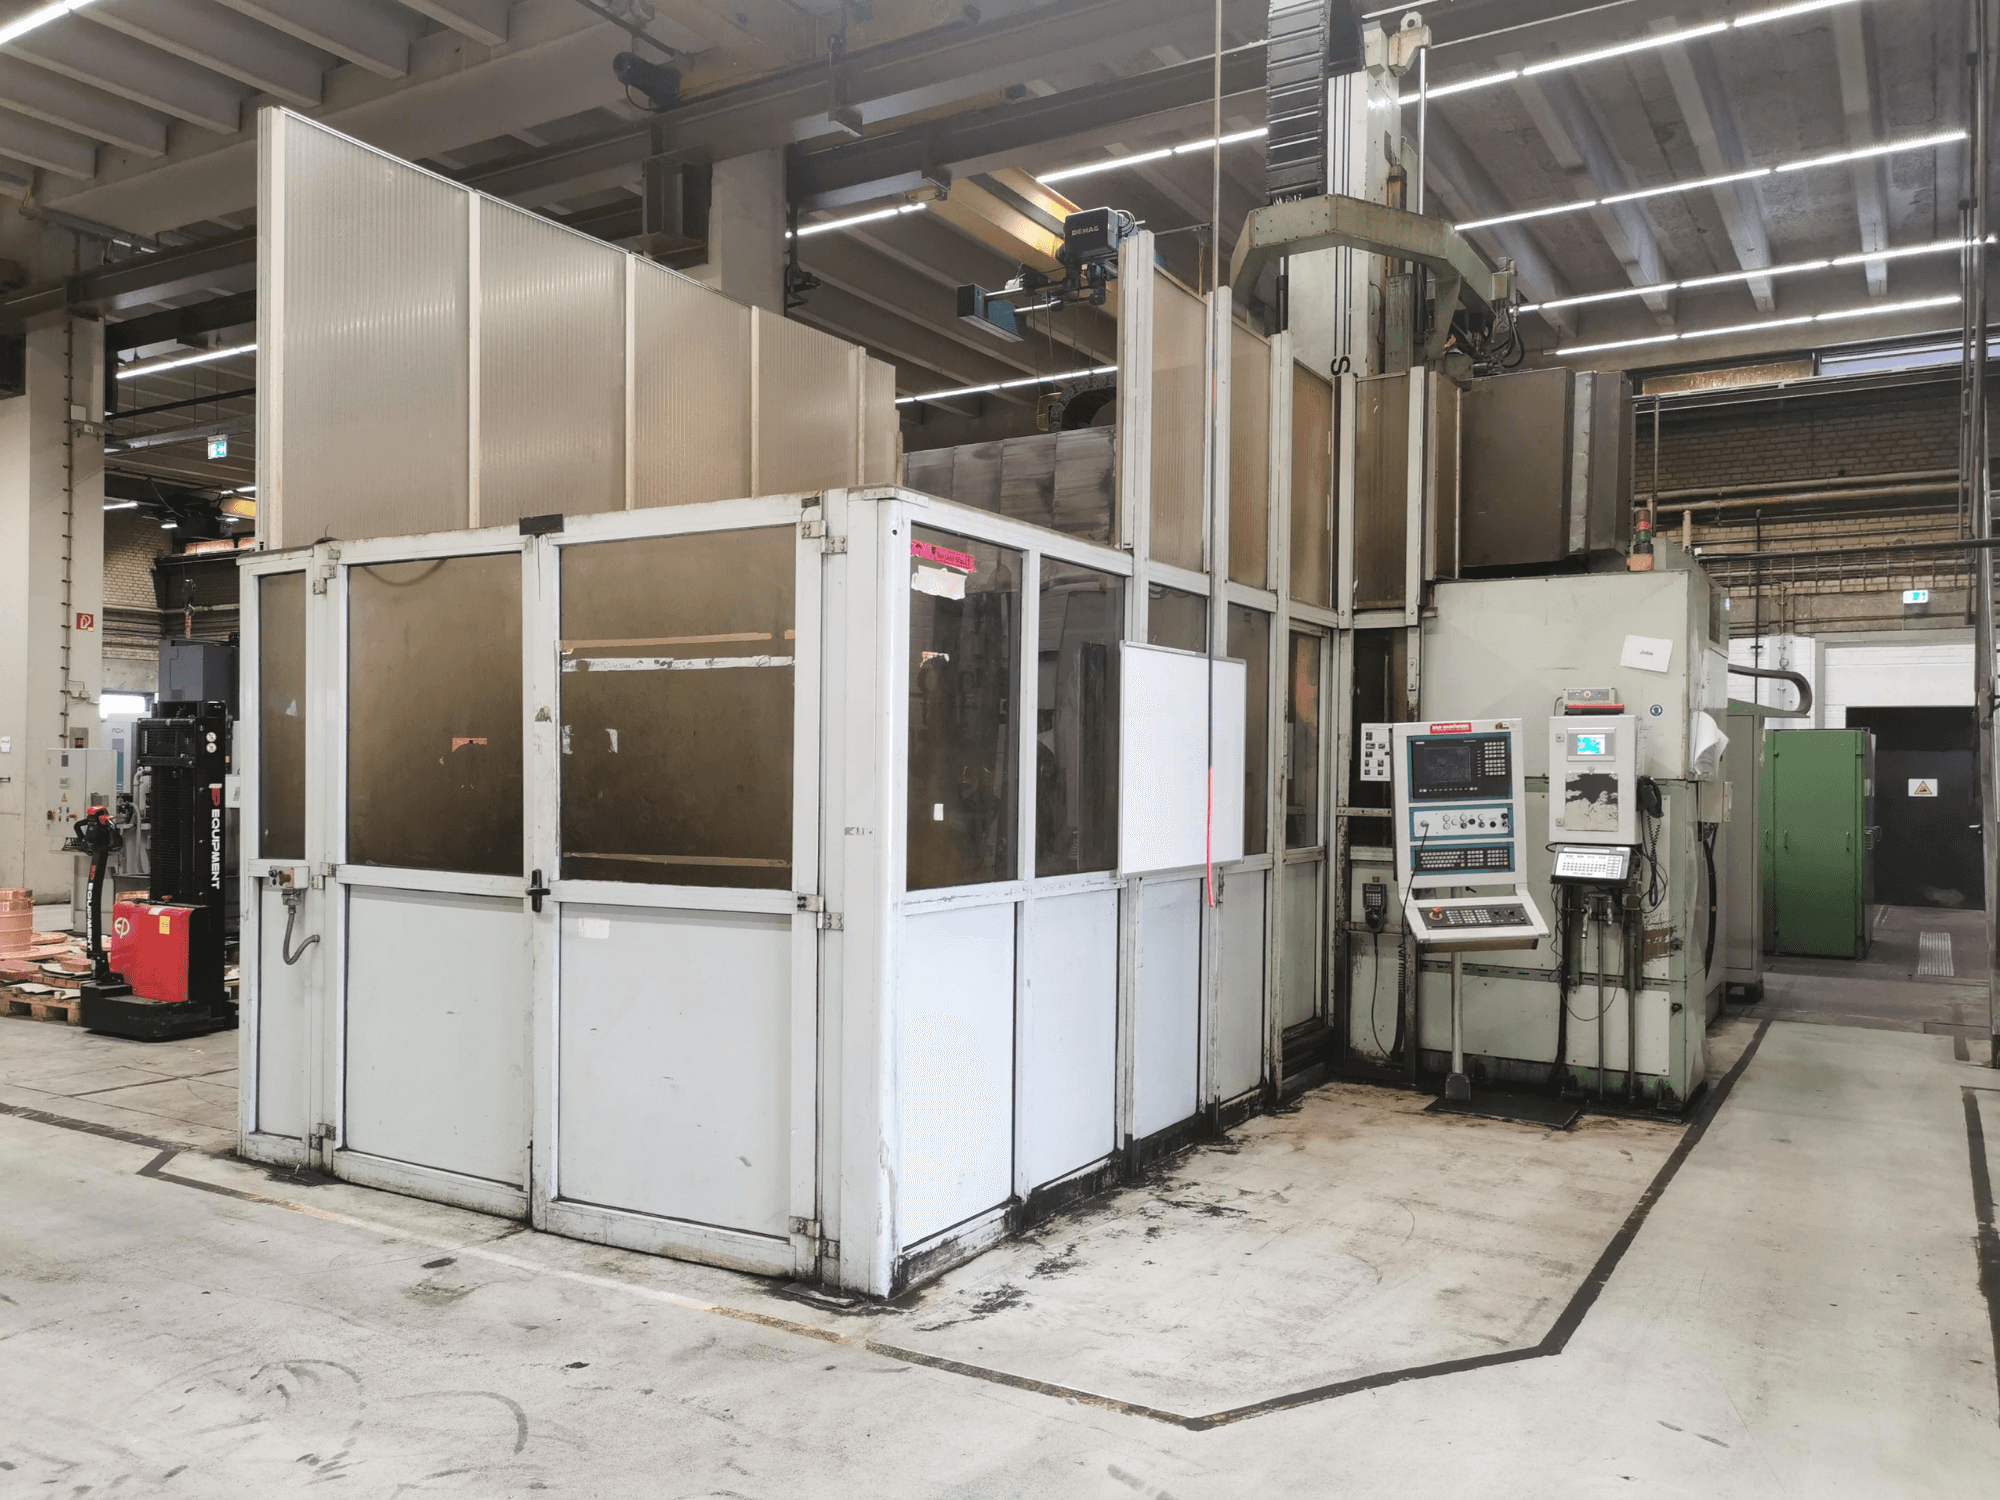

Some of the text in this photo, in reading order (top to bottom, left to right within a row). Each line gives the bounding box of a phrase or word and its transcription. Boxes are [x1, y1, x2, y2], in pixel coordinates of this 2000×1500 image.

[1071, 225, 1100, 236] DEMAG
[211, 808, 221, 890] EQUIPMENT
[86, 882, 94, 952] EQUIPMENT
